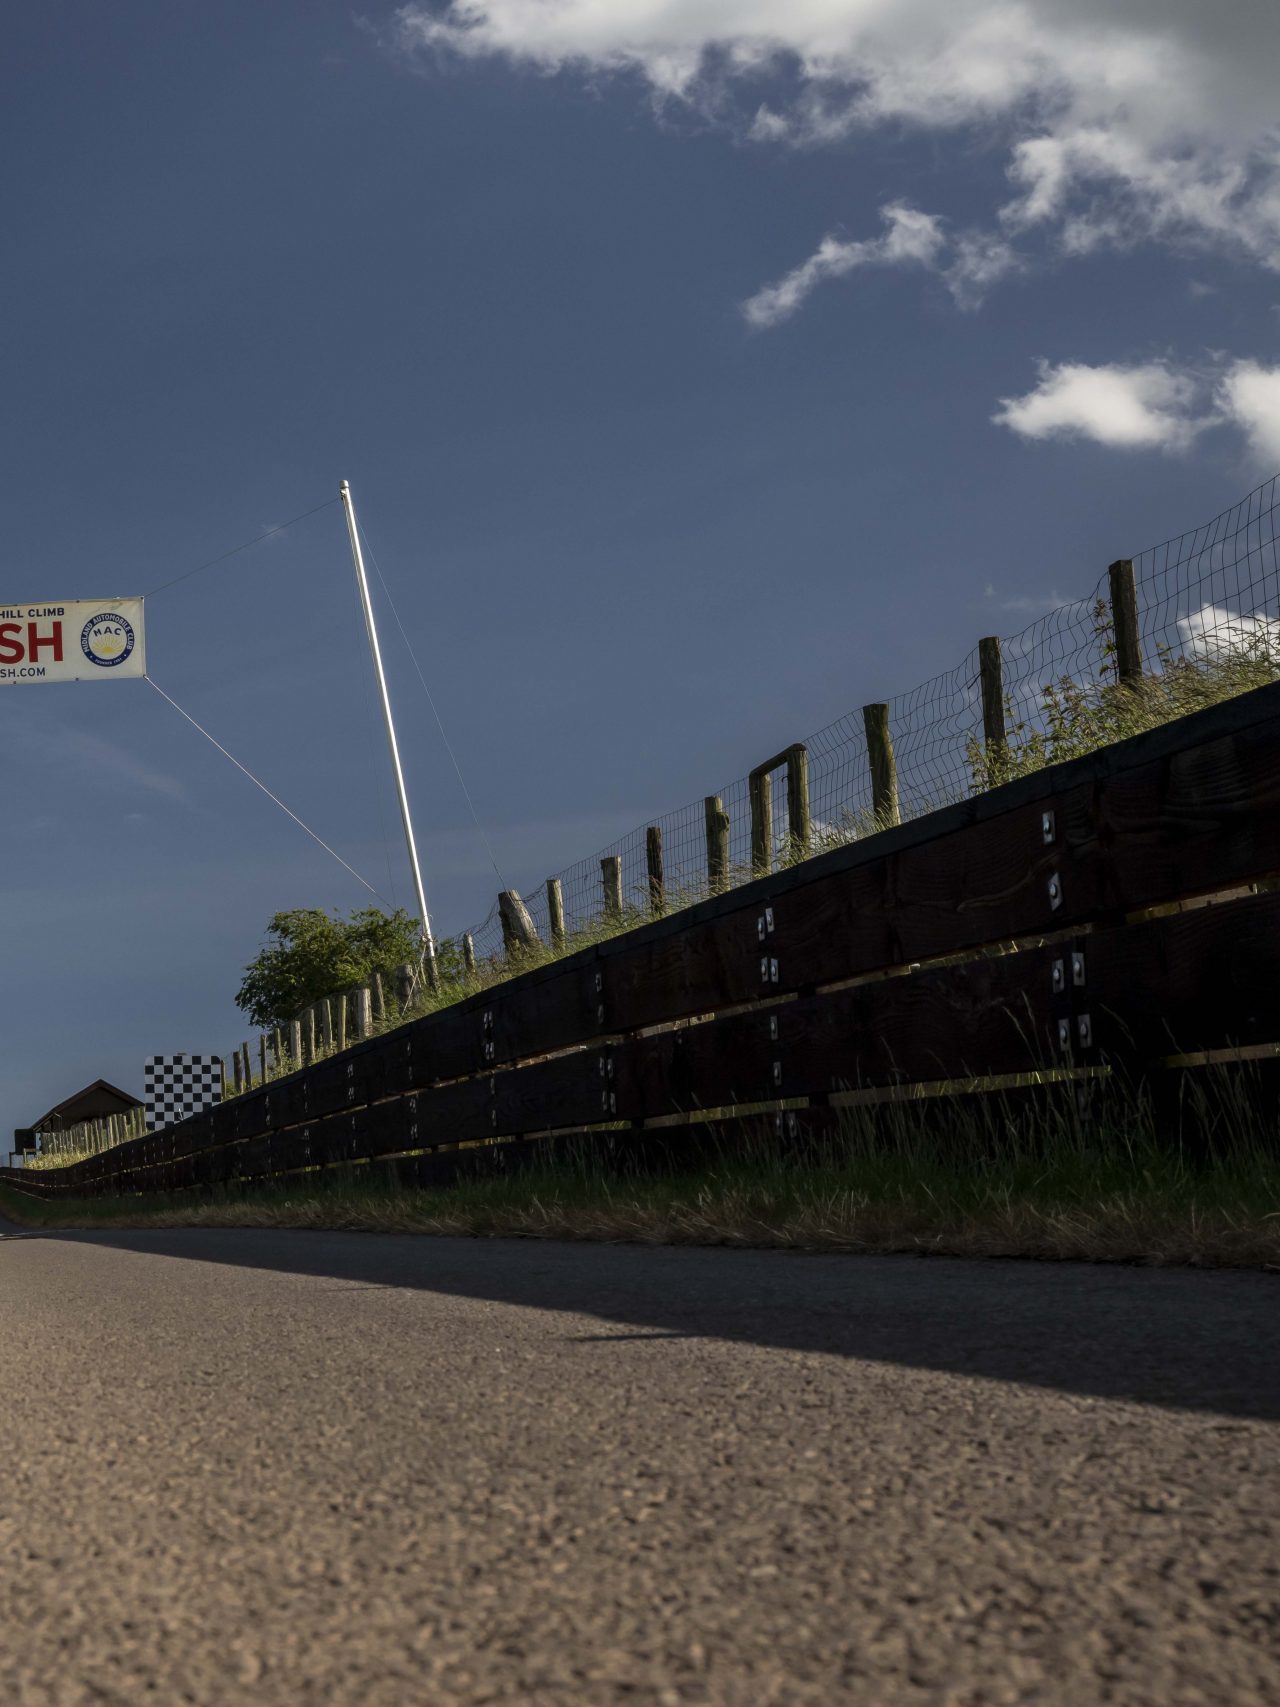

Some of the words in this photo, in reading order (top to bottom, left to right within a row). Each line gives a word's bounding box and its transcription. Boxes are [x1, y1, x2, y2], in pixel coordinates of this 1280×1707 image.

[28, 607, 65, 617] CLIMB
[81, 622, 93, 652] MIDLAND
[93, 614, 131, 631] AUTOMOBILE
[93, 626, 122, 637] MAC
